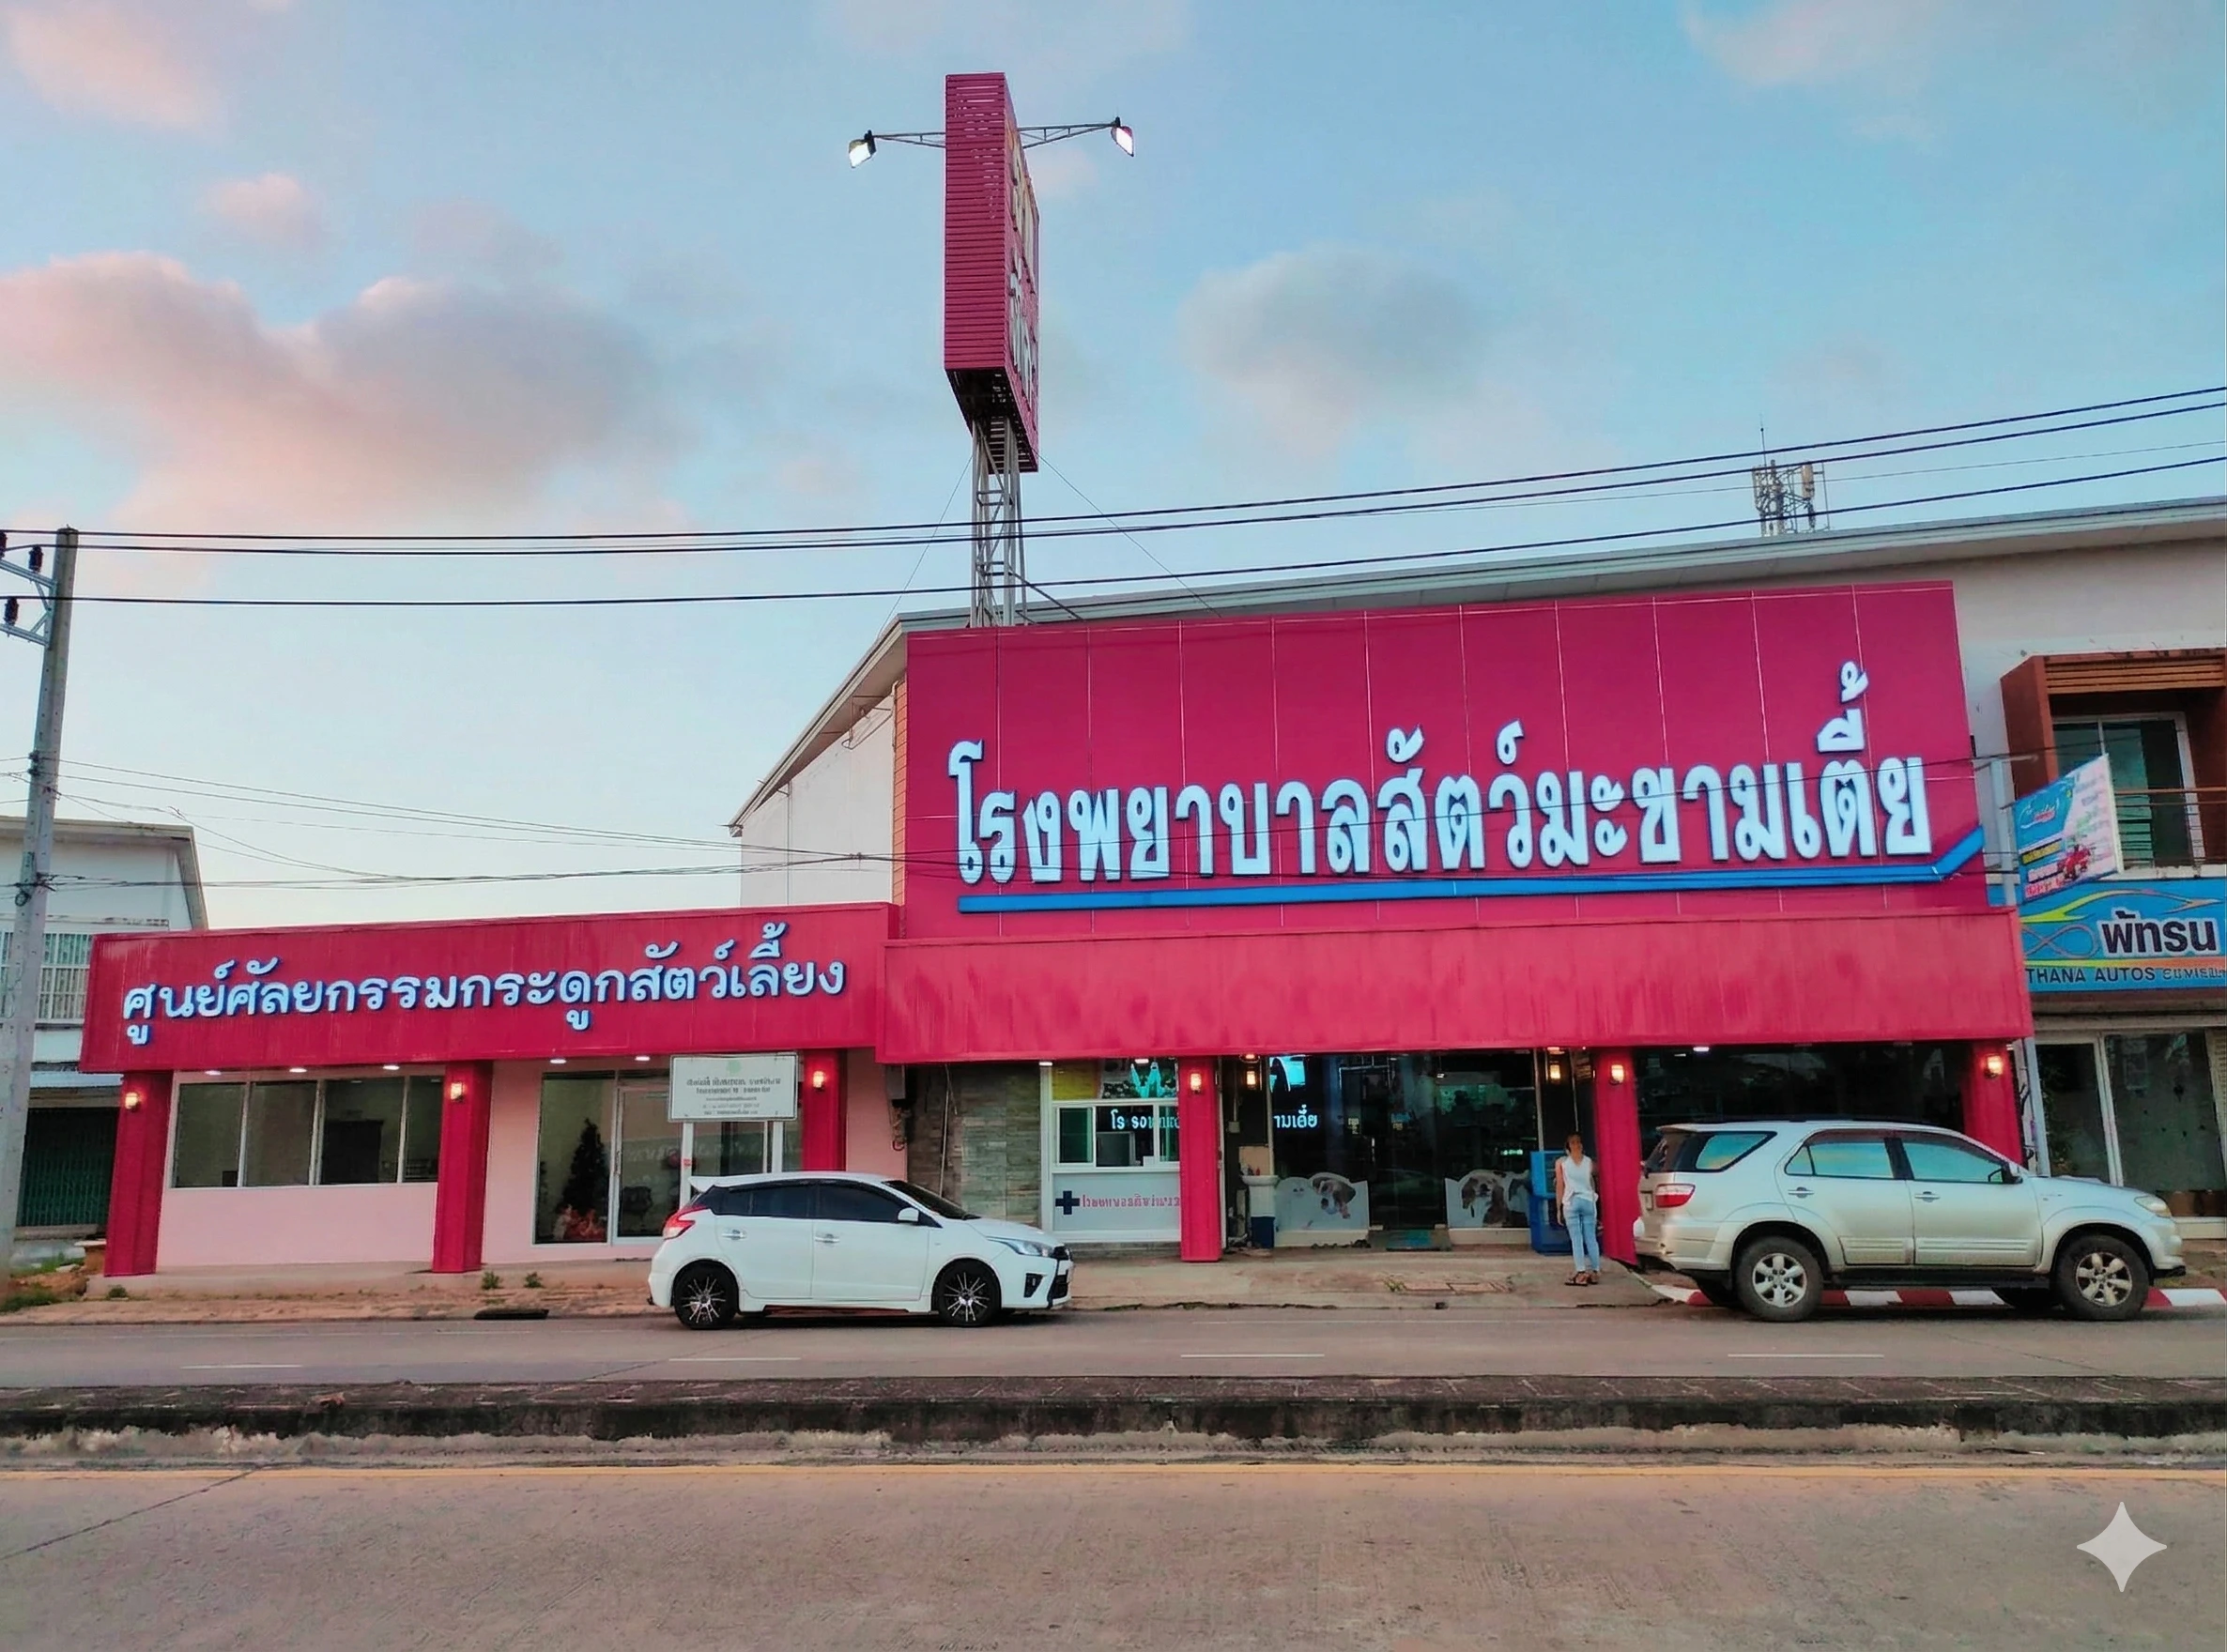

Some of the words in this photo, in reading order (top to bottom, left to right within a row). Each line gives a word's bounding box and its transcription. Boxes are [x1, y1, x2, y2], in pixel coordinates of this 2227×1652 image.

[948, 661, 1932, 885] โรงพยาบาลสัตว์มะขามเตี้ย
[123, 922, 845, 1046] ศูนย์ศัลยกรรมกระดูกสัตว์เลี้ยง
[2095, 967, 2156, 982] AUTOS
